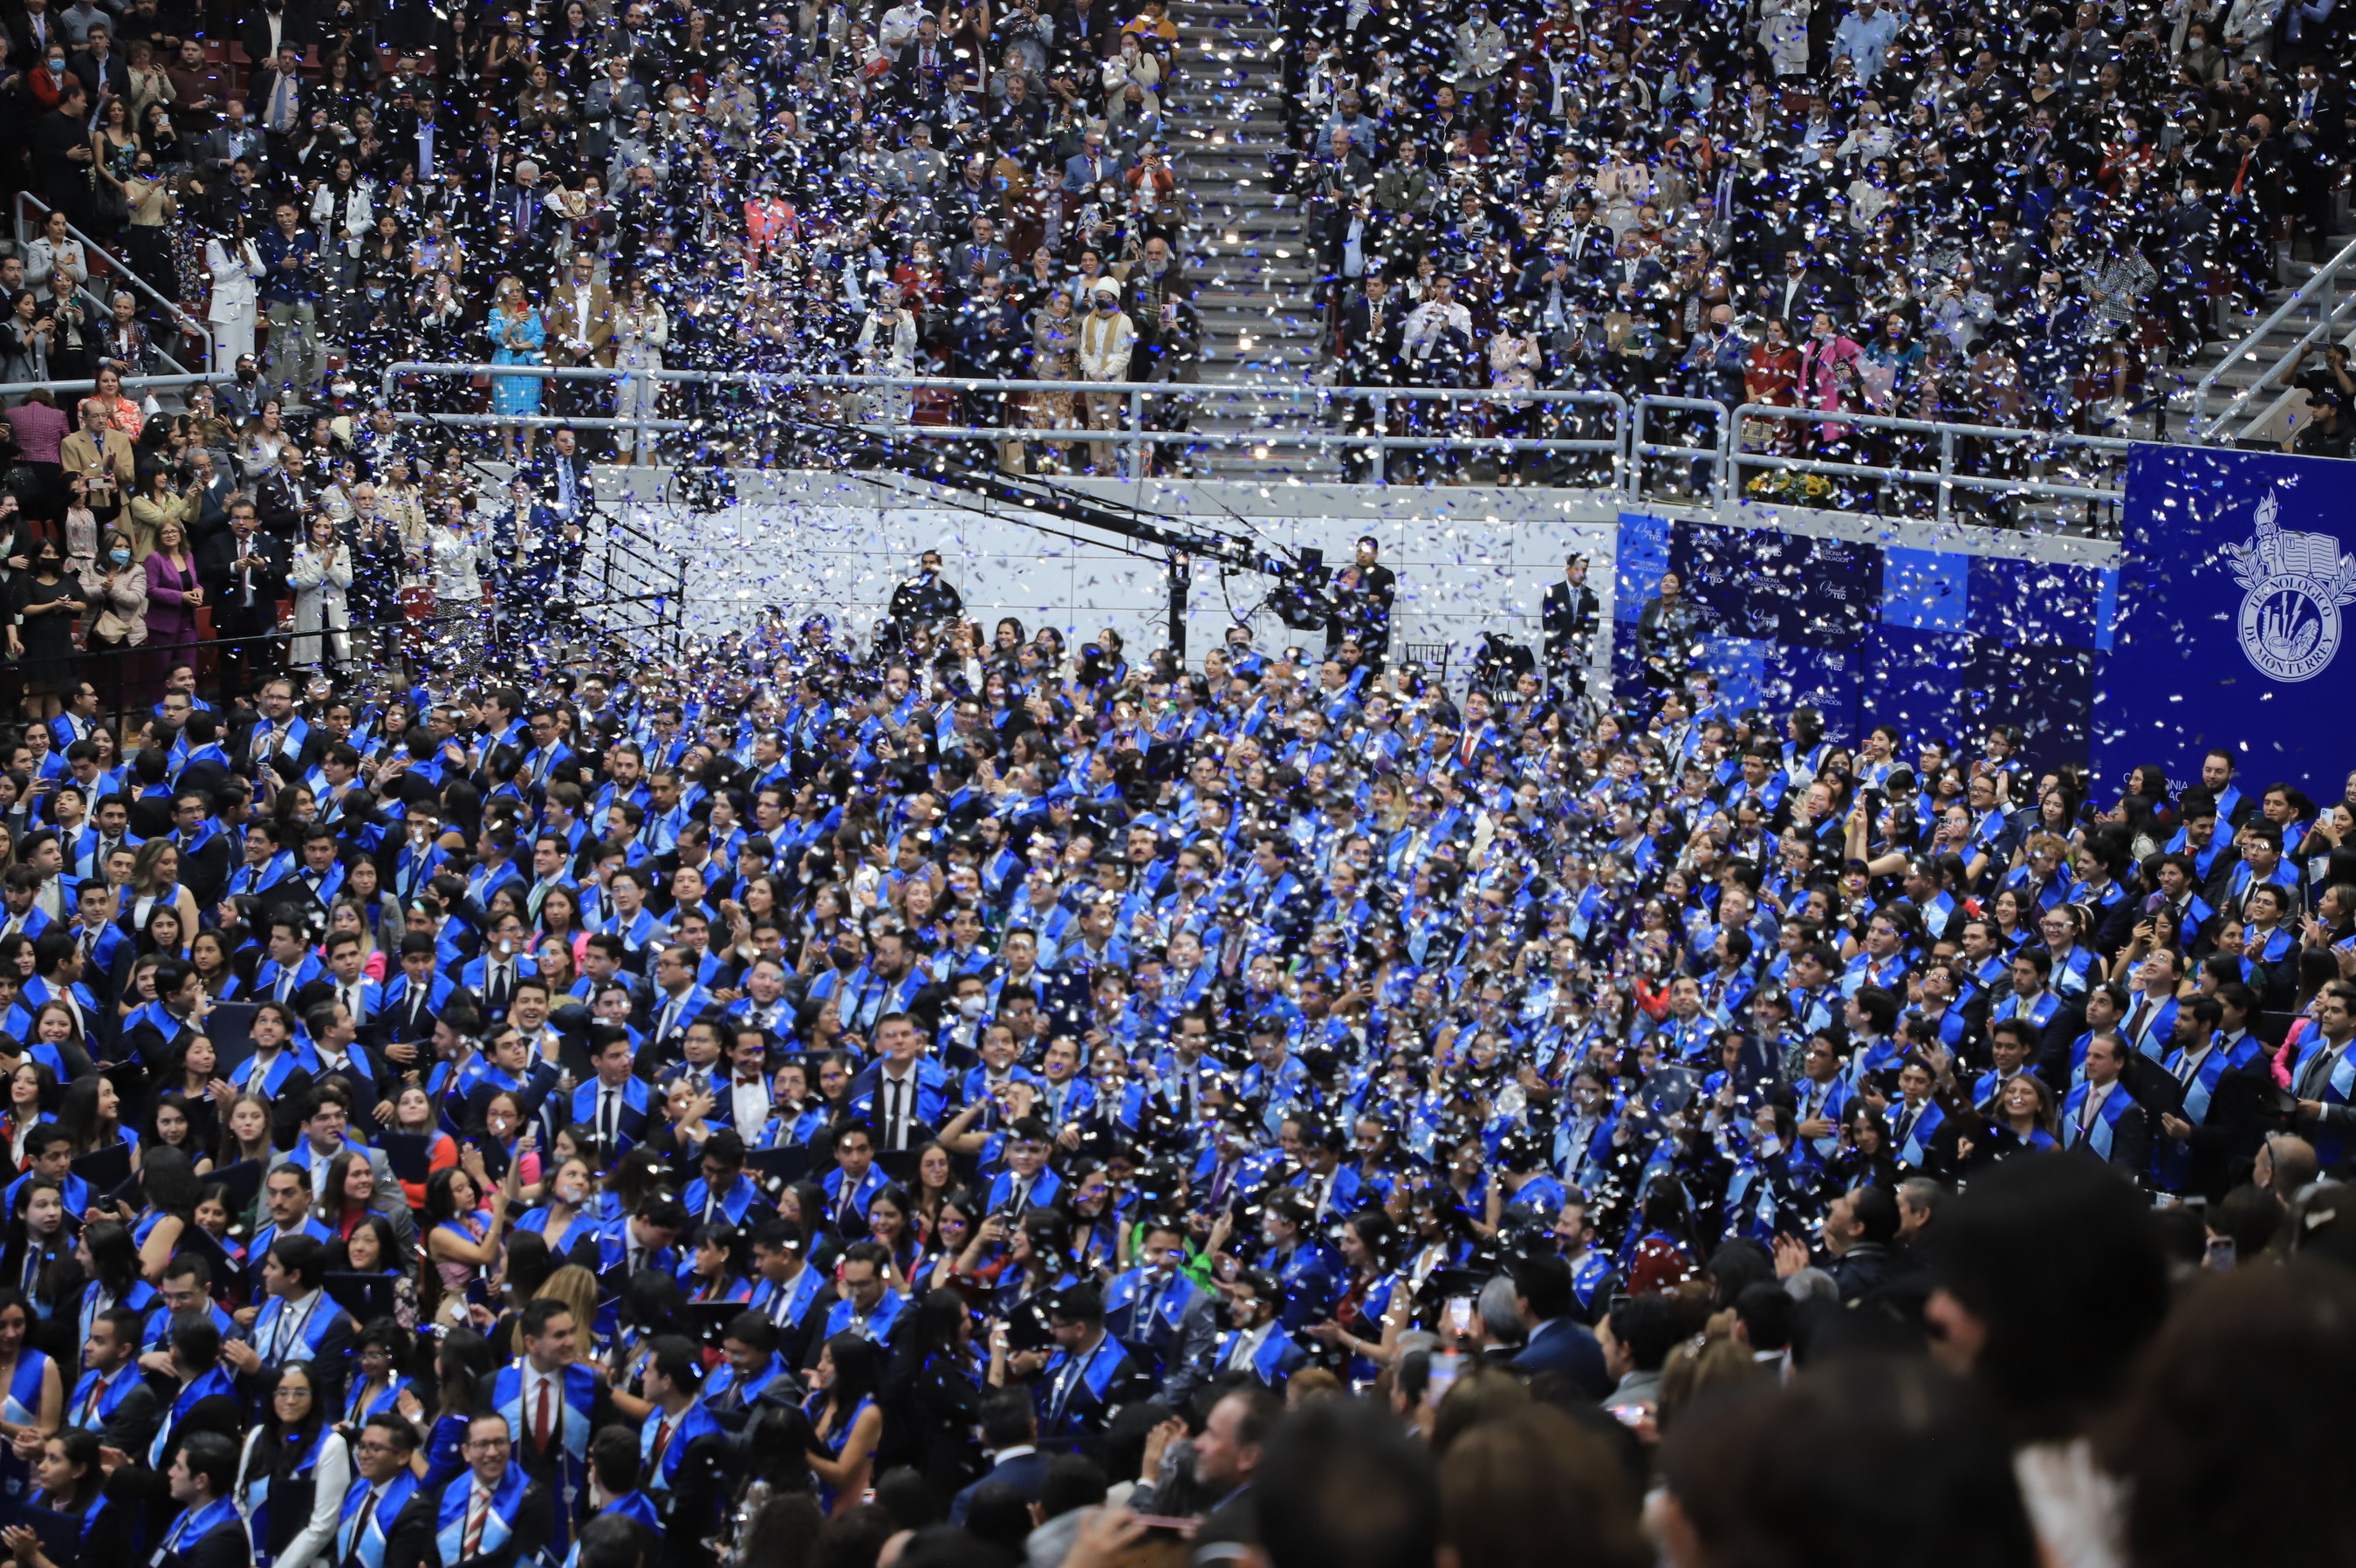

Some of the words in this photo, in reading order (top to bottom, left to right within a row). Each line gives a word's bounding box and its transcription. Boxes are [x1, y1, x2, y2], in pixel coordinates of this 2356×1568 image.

[1816, 580, 1846, 598] Orgullo
[2249, 577, 2332, 618] TECNOLOGICO
[2244, 626, 2258, 647] DE
[2254, 634, 2332, 674] MONTERREY
